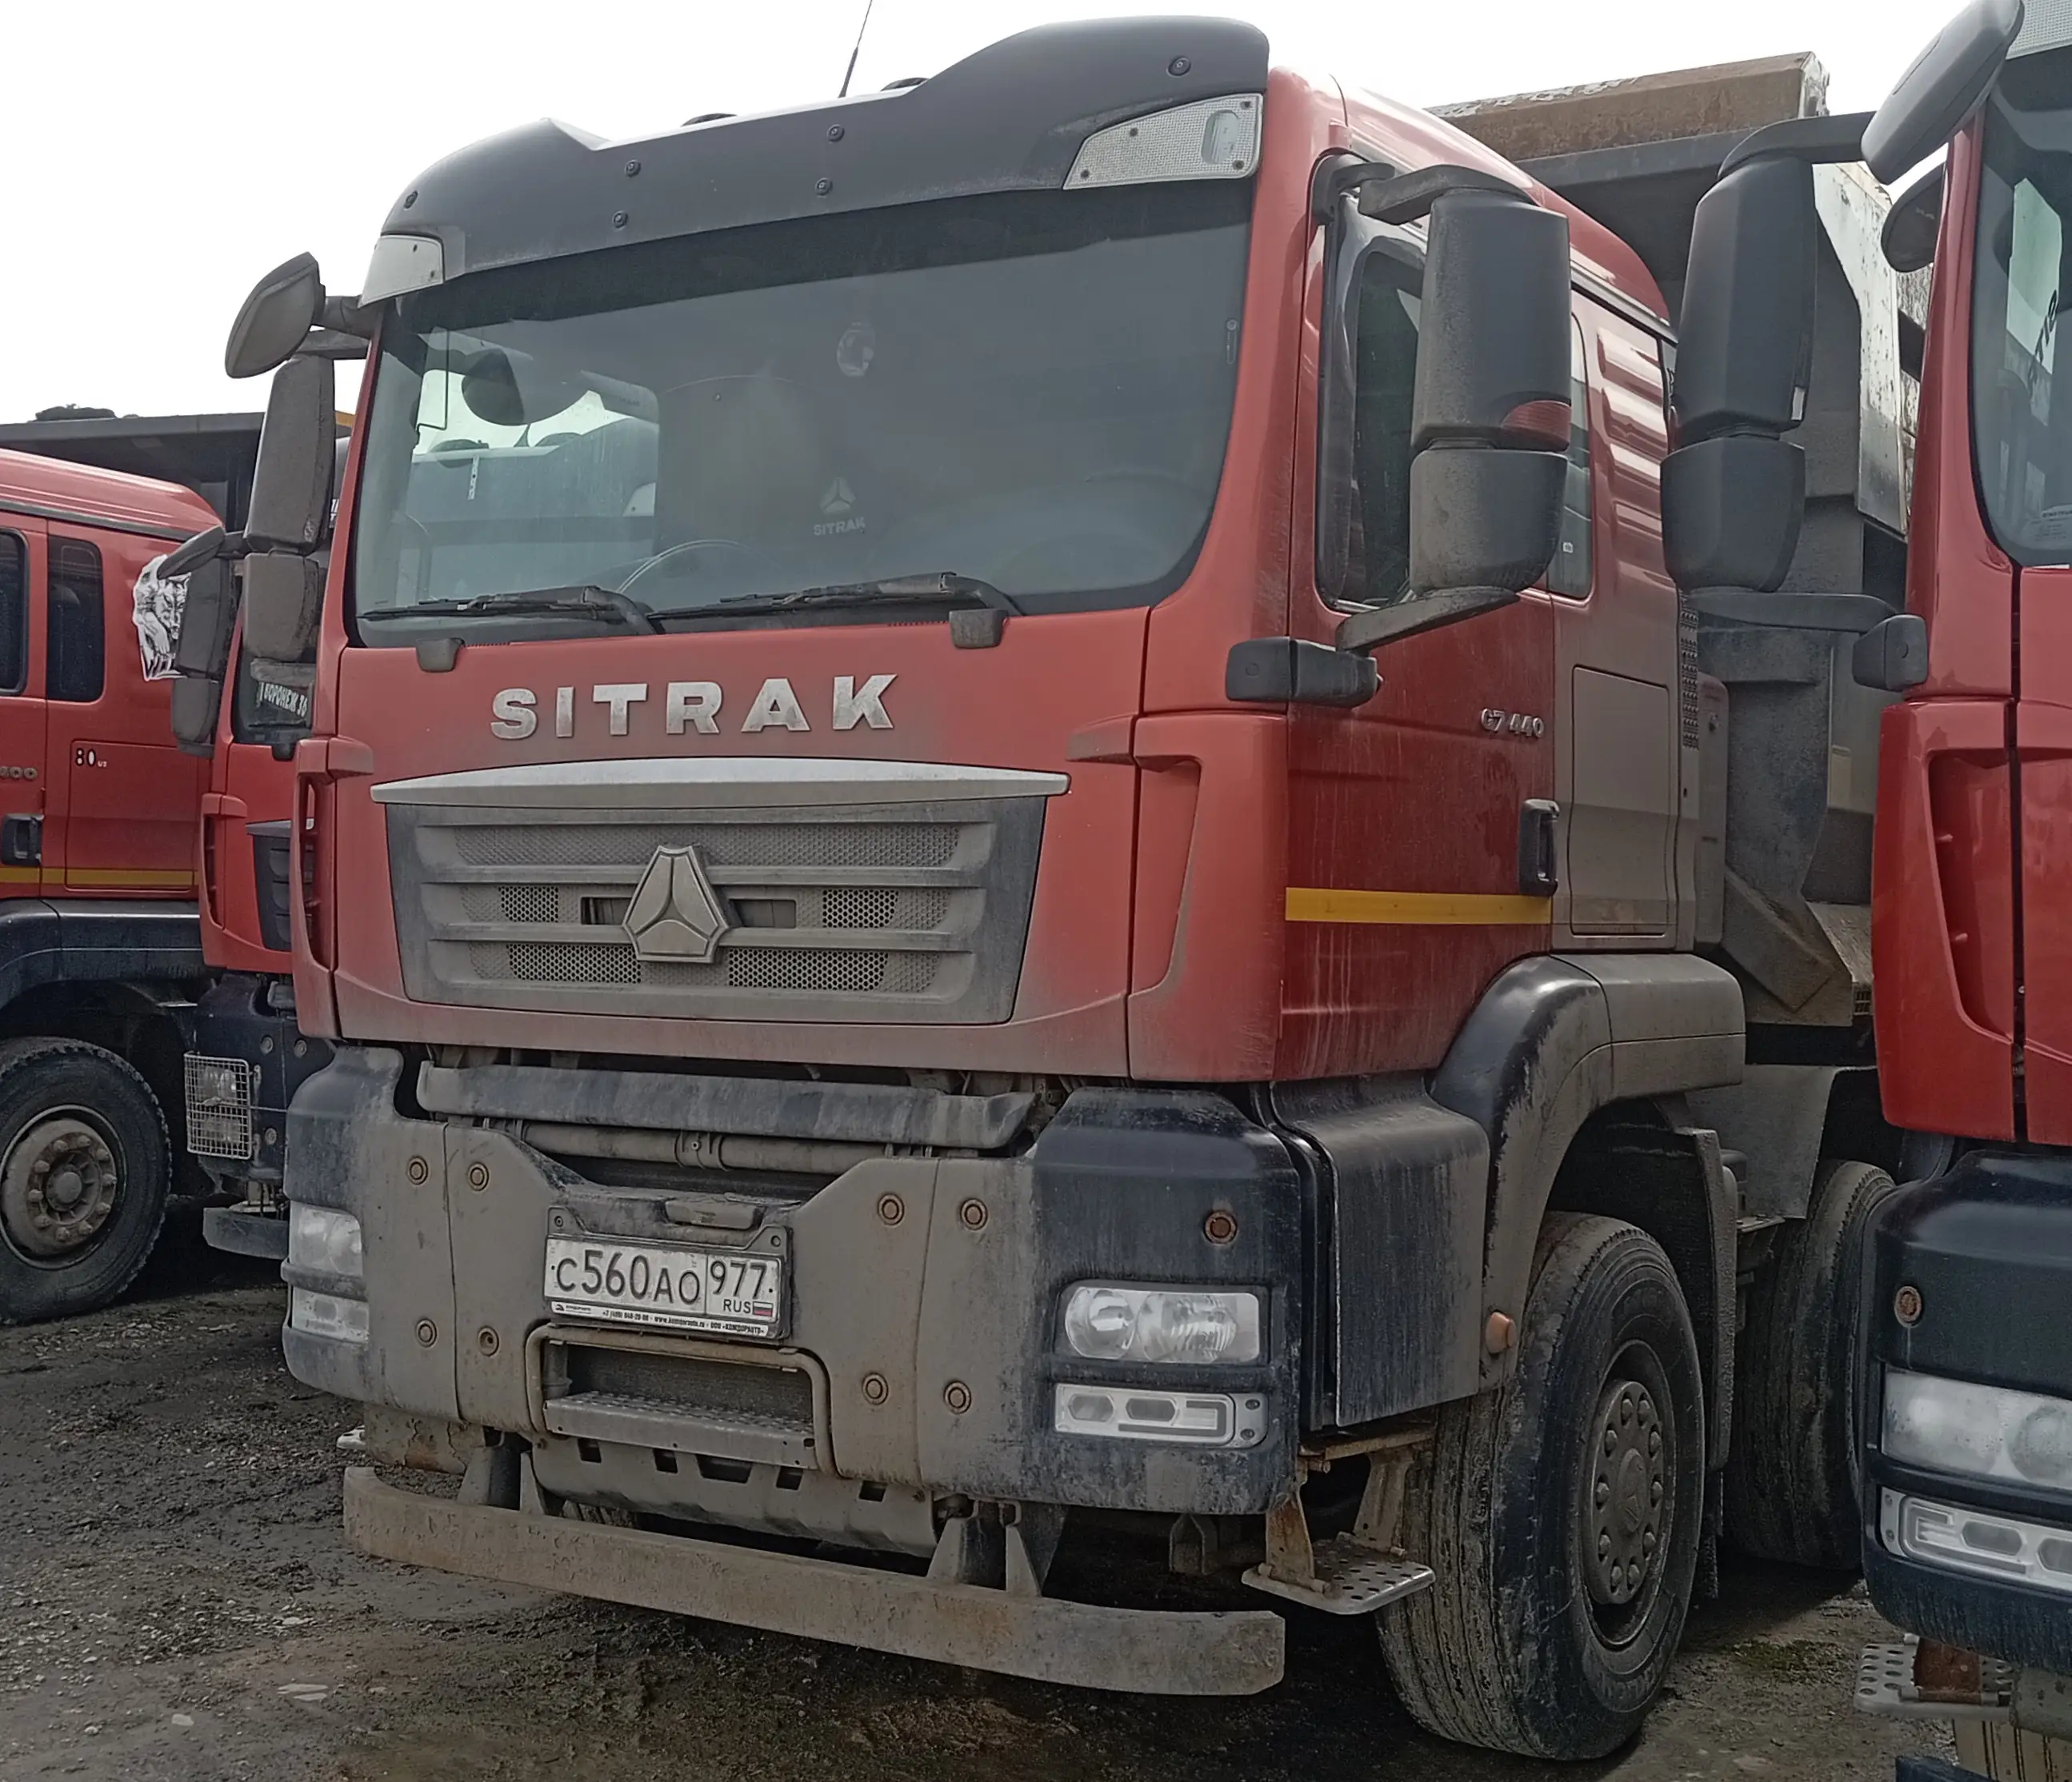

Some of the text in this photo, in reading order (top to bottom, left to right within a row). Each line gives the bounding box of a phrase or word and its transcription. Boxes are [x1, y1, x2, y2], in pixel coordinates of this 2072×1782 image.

[813, 517, 866, 535] SITRAK
[490, 674, 897, 739] SITRAK
[710, 1260, 767, 1301] 977
[723, 1298, 751, 1314] RUS
